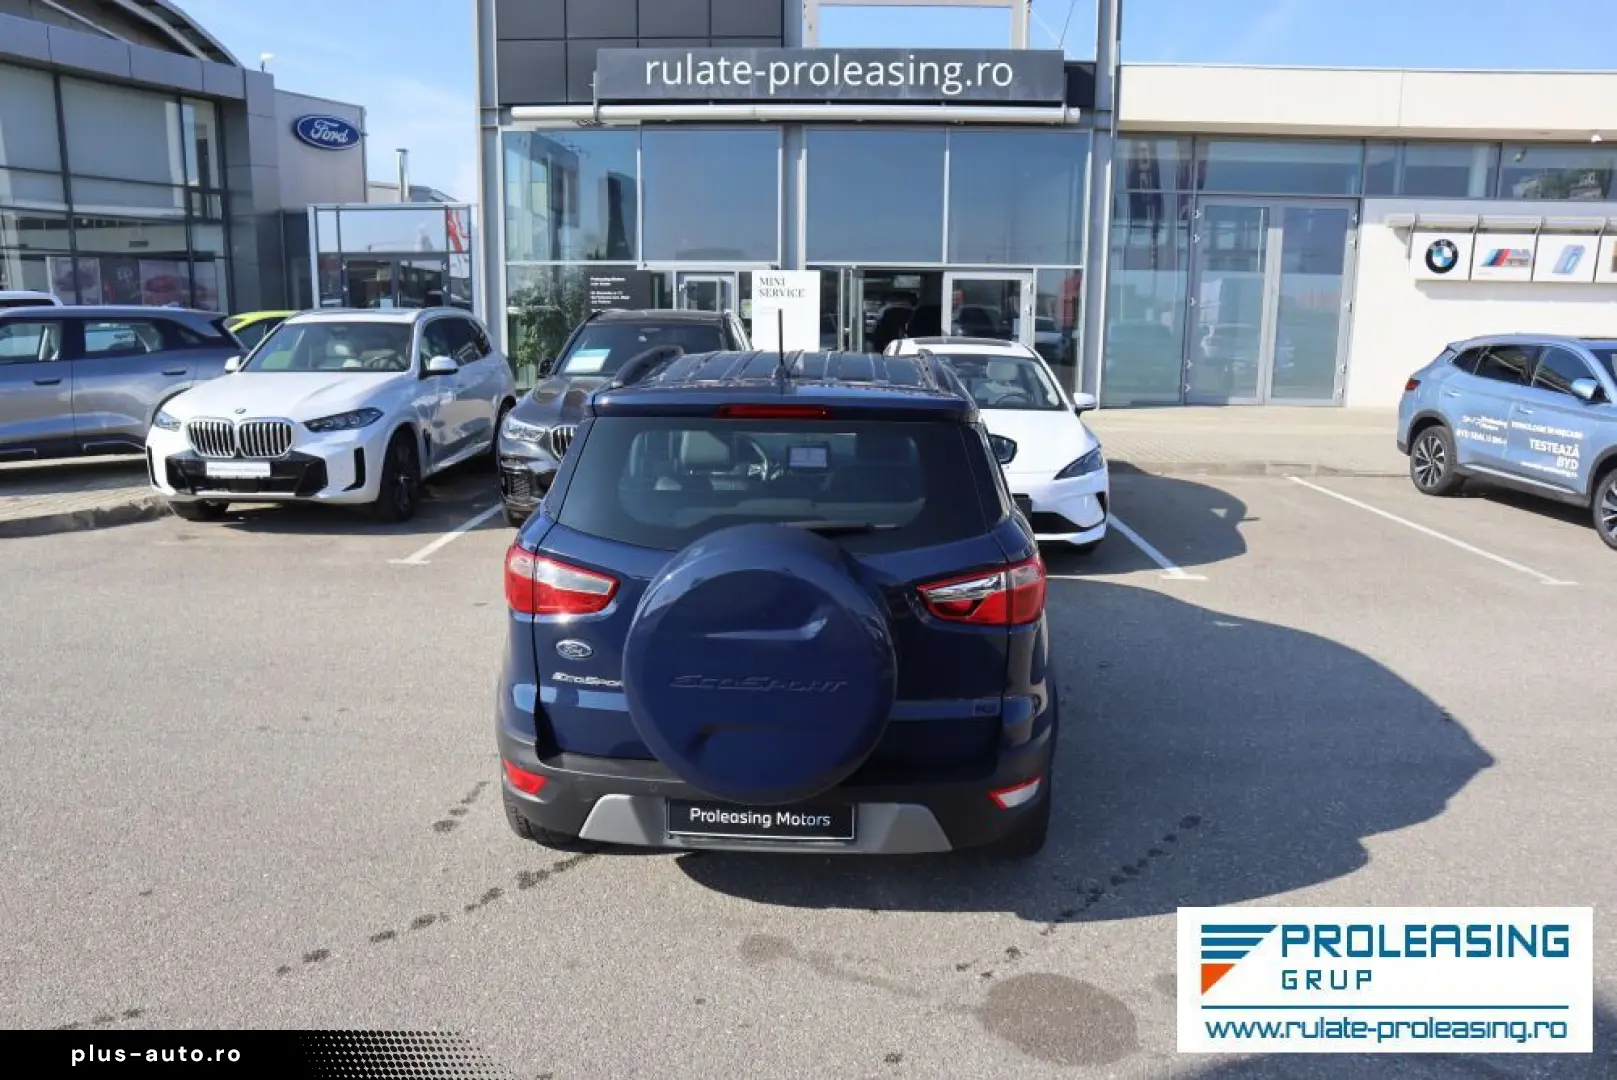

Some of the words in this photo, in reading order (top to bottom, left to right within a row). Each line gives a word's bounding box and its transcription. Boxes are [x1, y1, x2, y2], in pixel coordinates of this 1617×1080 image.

[645, 54, 1013, 95] rulate-proleasing.ro
[311, 119, 348, 143] Ford
[759, 277, 786, 287] MINI
[759, 288, 806, 298] SERVICE
[1556, 456, 1579, 470] BYD
[689, 807, 771, 828] Proleasing
[776, 811, 831, 827] Motors
